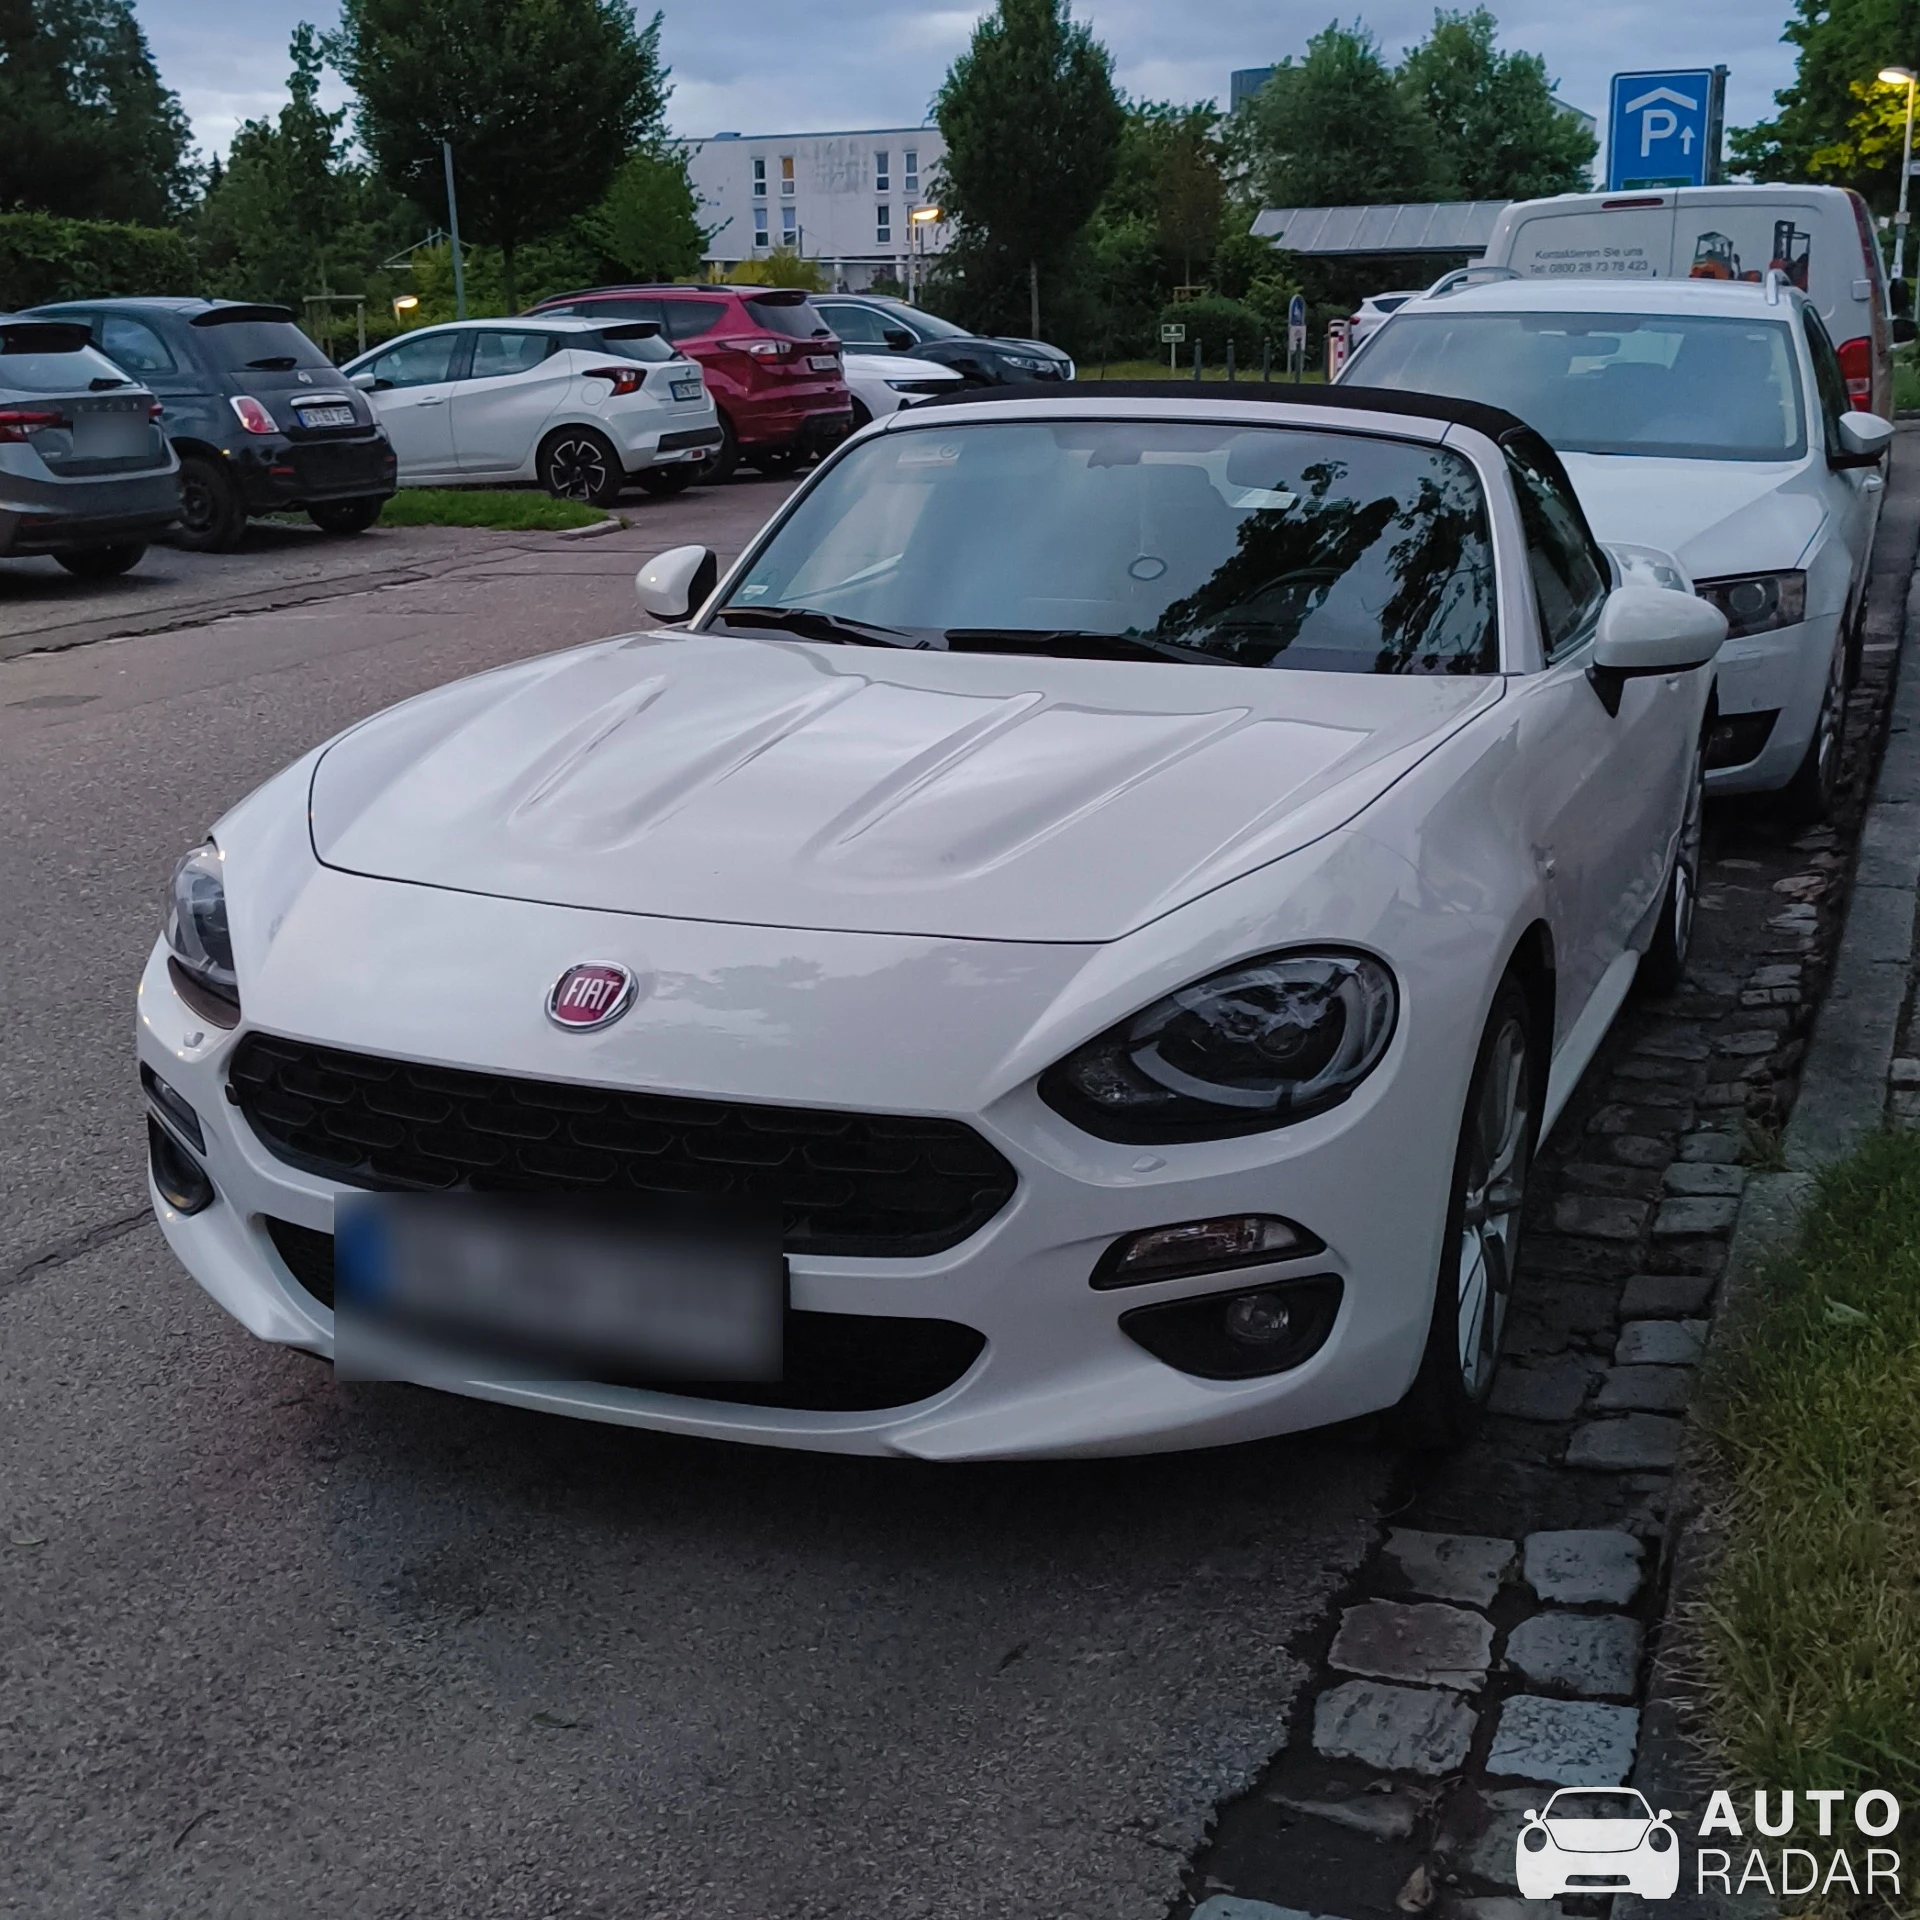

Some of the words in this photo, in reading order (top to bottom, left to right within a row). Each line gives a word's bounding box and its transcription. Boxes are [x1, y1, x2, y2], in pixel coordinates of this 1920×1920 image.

[1641, 109, 1678, 158] P
[1535, 249, 1601, 259] Kontaktieren
[1603, 247, 1621, 258] Sie
[1623, 248, 1644, 257] uns
[562, 976, 620, 1011] FIAT
